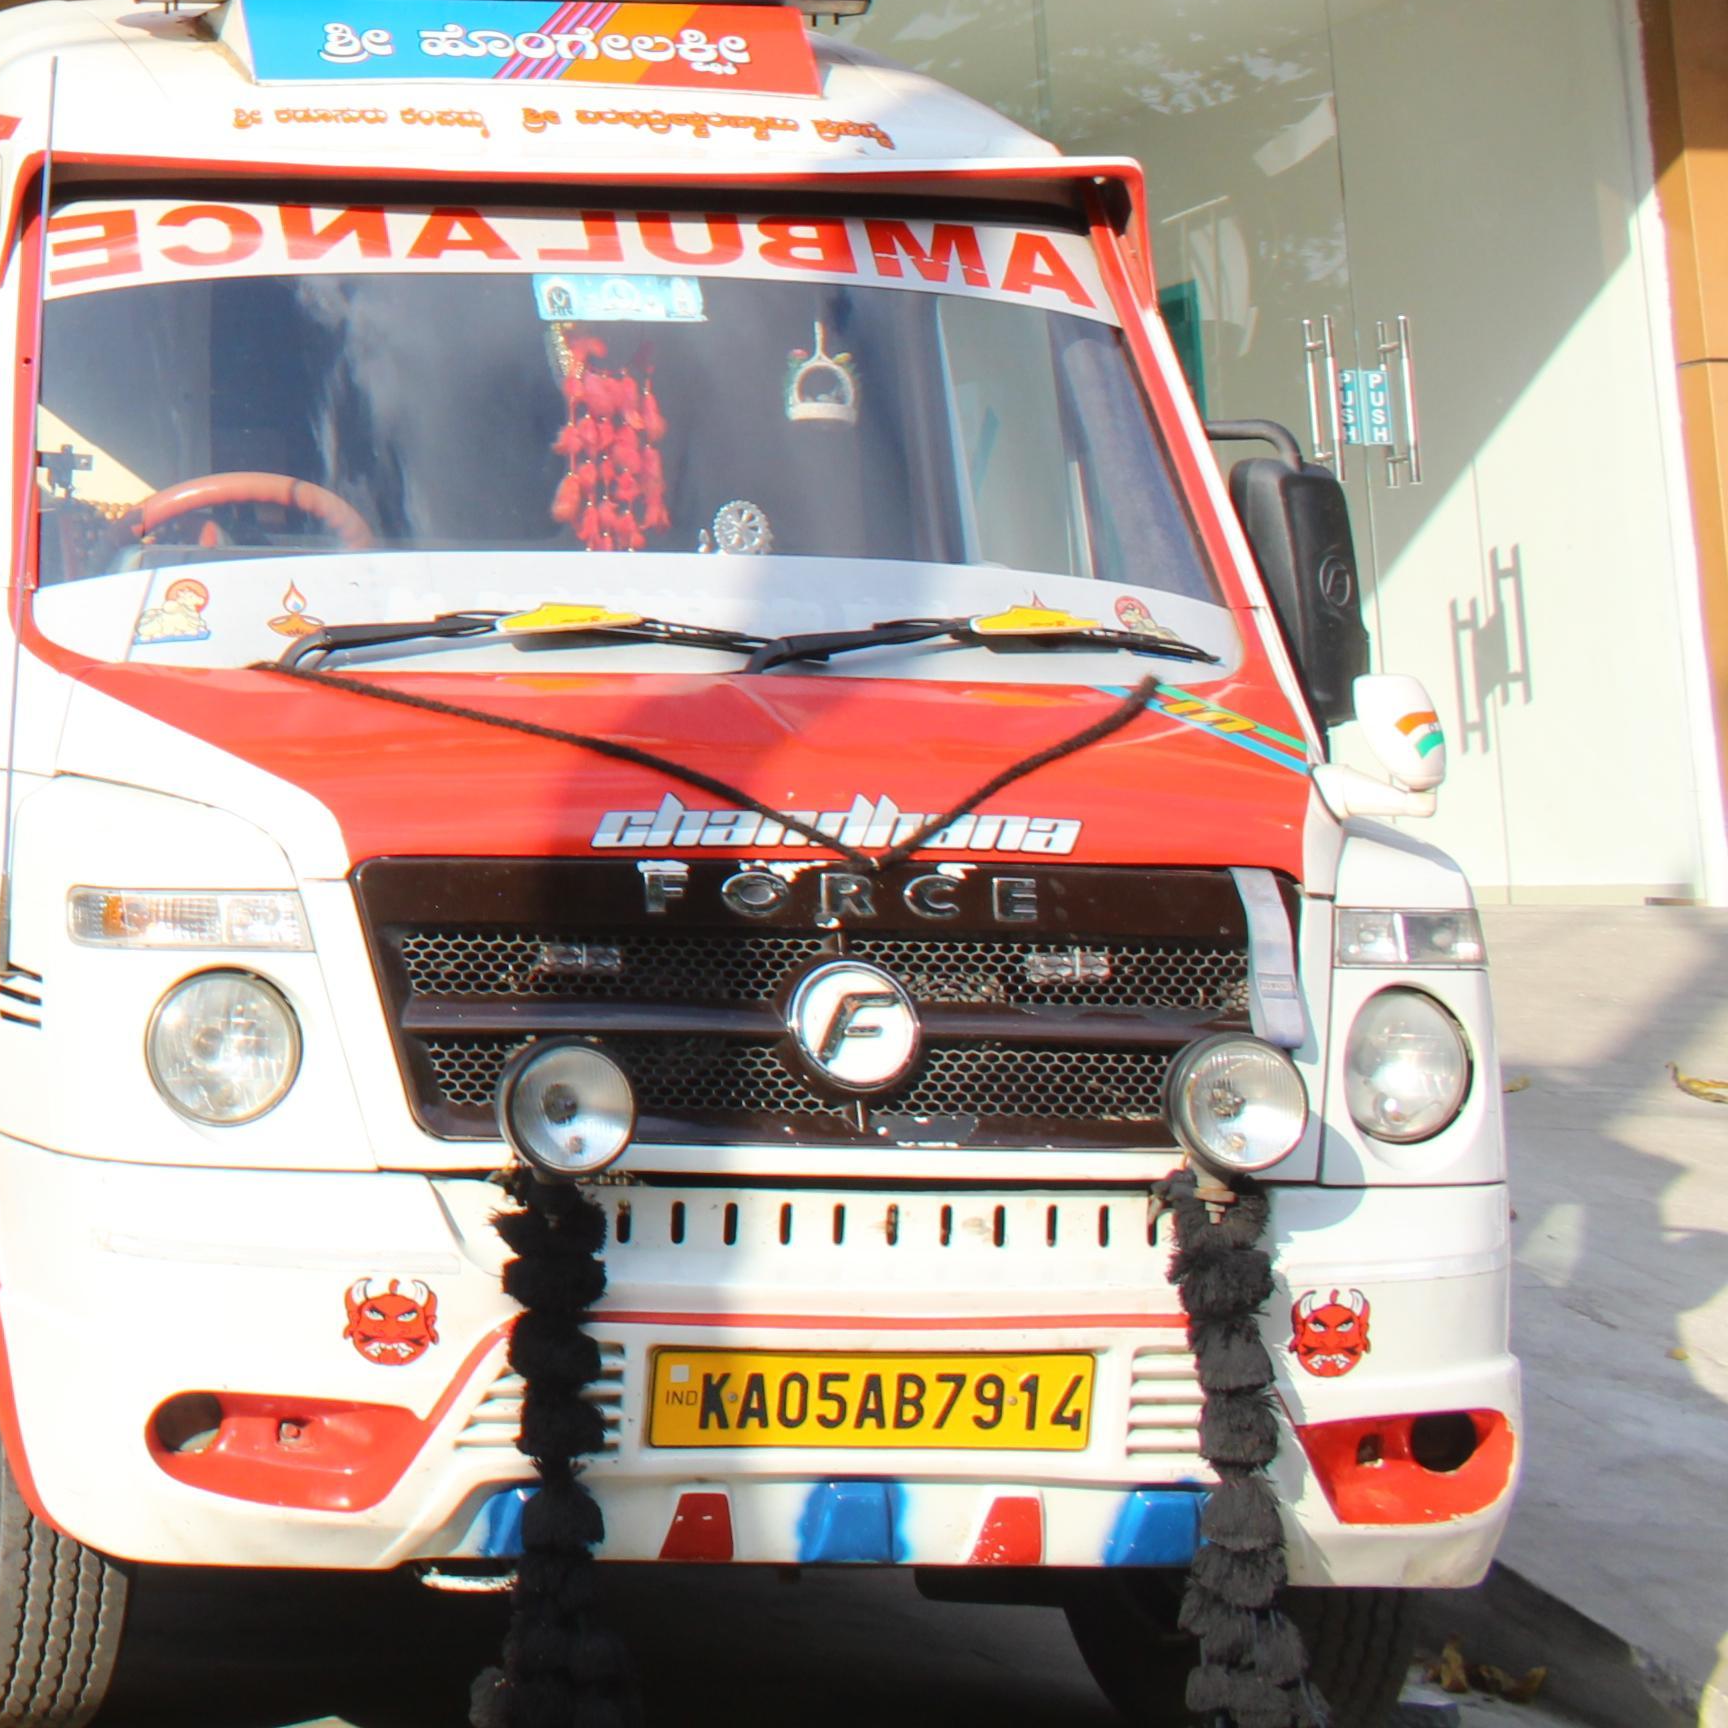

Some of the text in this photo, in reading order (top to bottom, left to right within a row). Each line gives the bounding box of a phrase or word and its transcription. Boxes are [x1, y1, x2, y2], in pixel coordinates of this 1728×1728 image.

[1369, 372, 1389, 443] PUSH
[642, 869, 1040, 924] FORCE
[665, 1371, 1085, 1432] IND KA05AB7914
